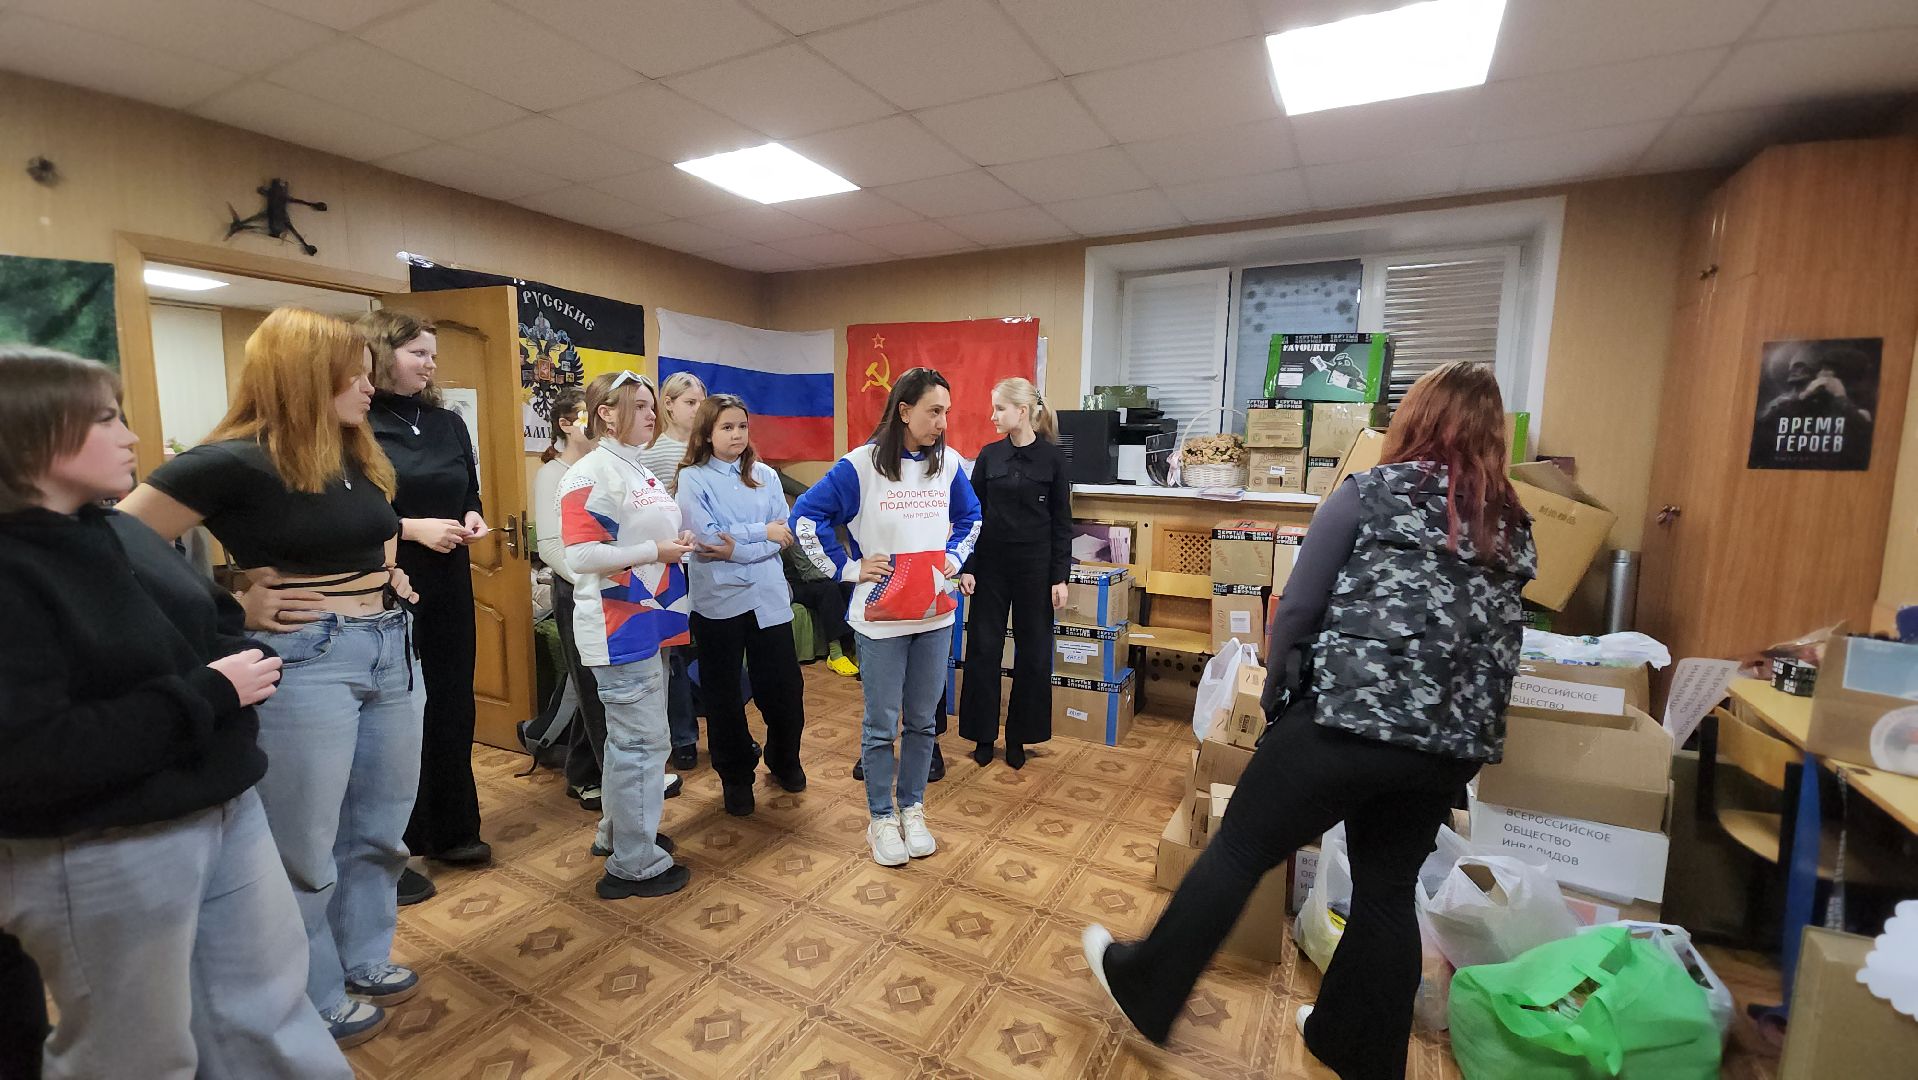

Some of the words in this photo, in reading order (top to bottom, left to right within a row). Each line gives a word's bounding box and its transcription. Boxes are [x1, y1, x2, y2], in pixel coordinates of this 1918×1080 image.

[523, 290, 596, 331] РУССКИЕ
[1283, 344, 1337, 352] FAVOURITE
[1778, 417, 1846, 434] ВРЕМЯ
[1775, 435, 1844, 452] ГЕРОЕВ
[1513, 681, 1600, 702] СЕРОССИЙСКОЕ
[1512, 694, 1565, 711] БЩЕСТВО
[1506, 808, 1612, 843] ВСЕРОССИЙСКОЕ
[1504, 823, 1572, 848] ОБЩЕСТВО
